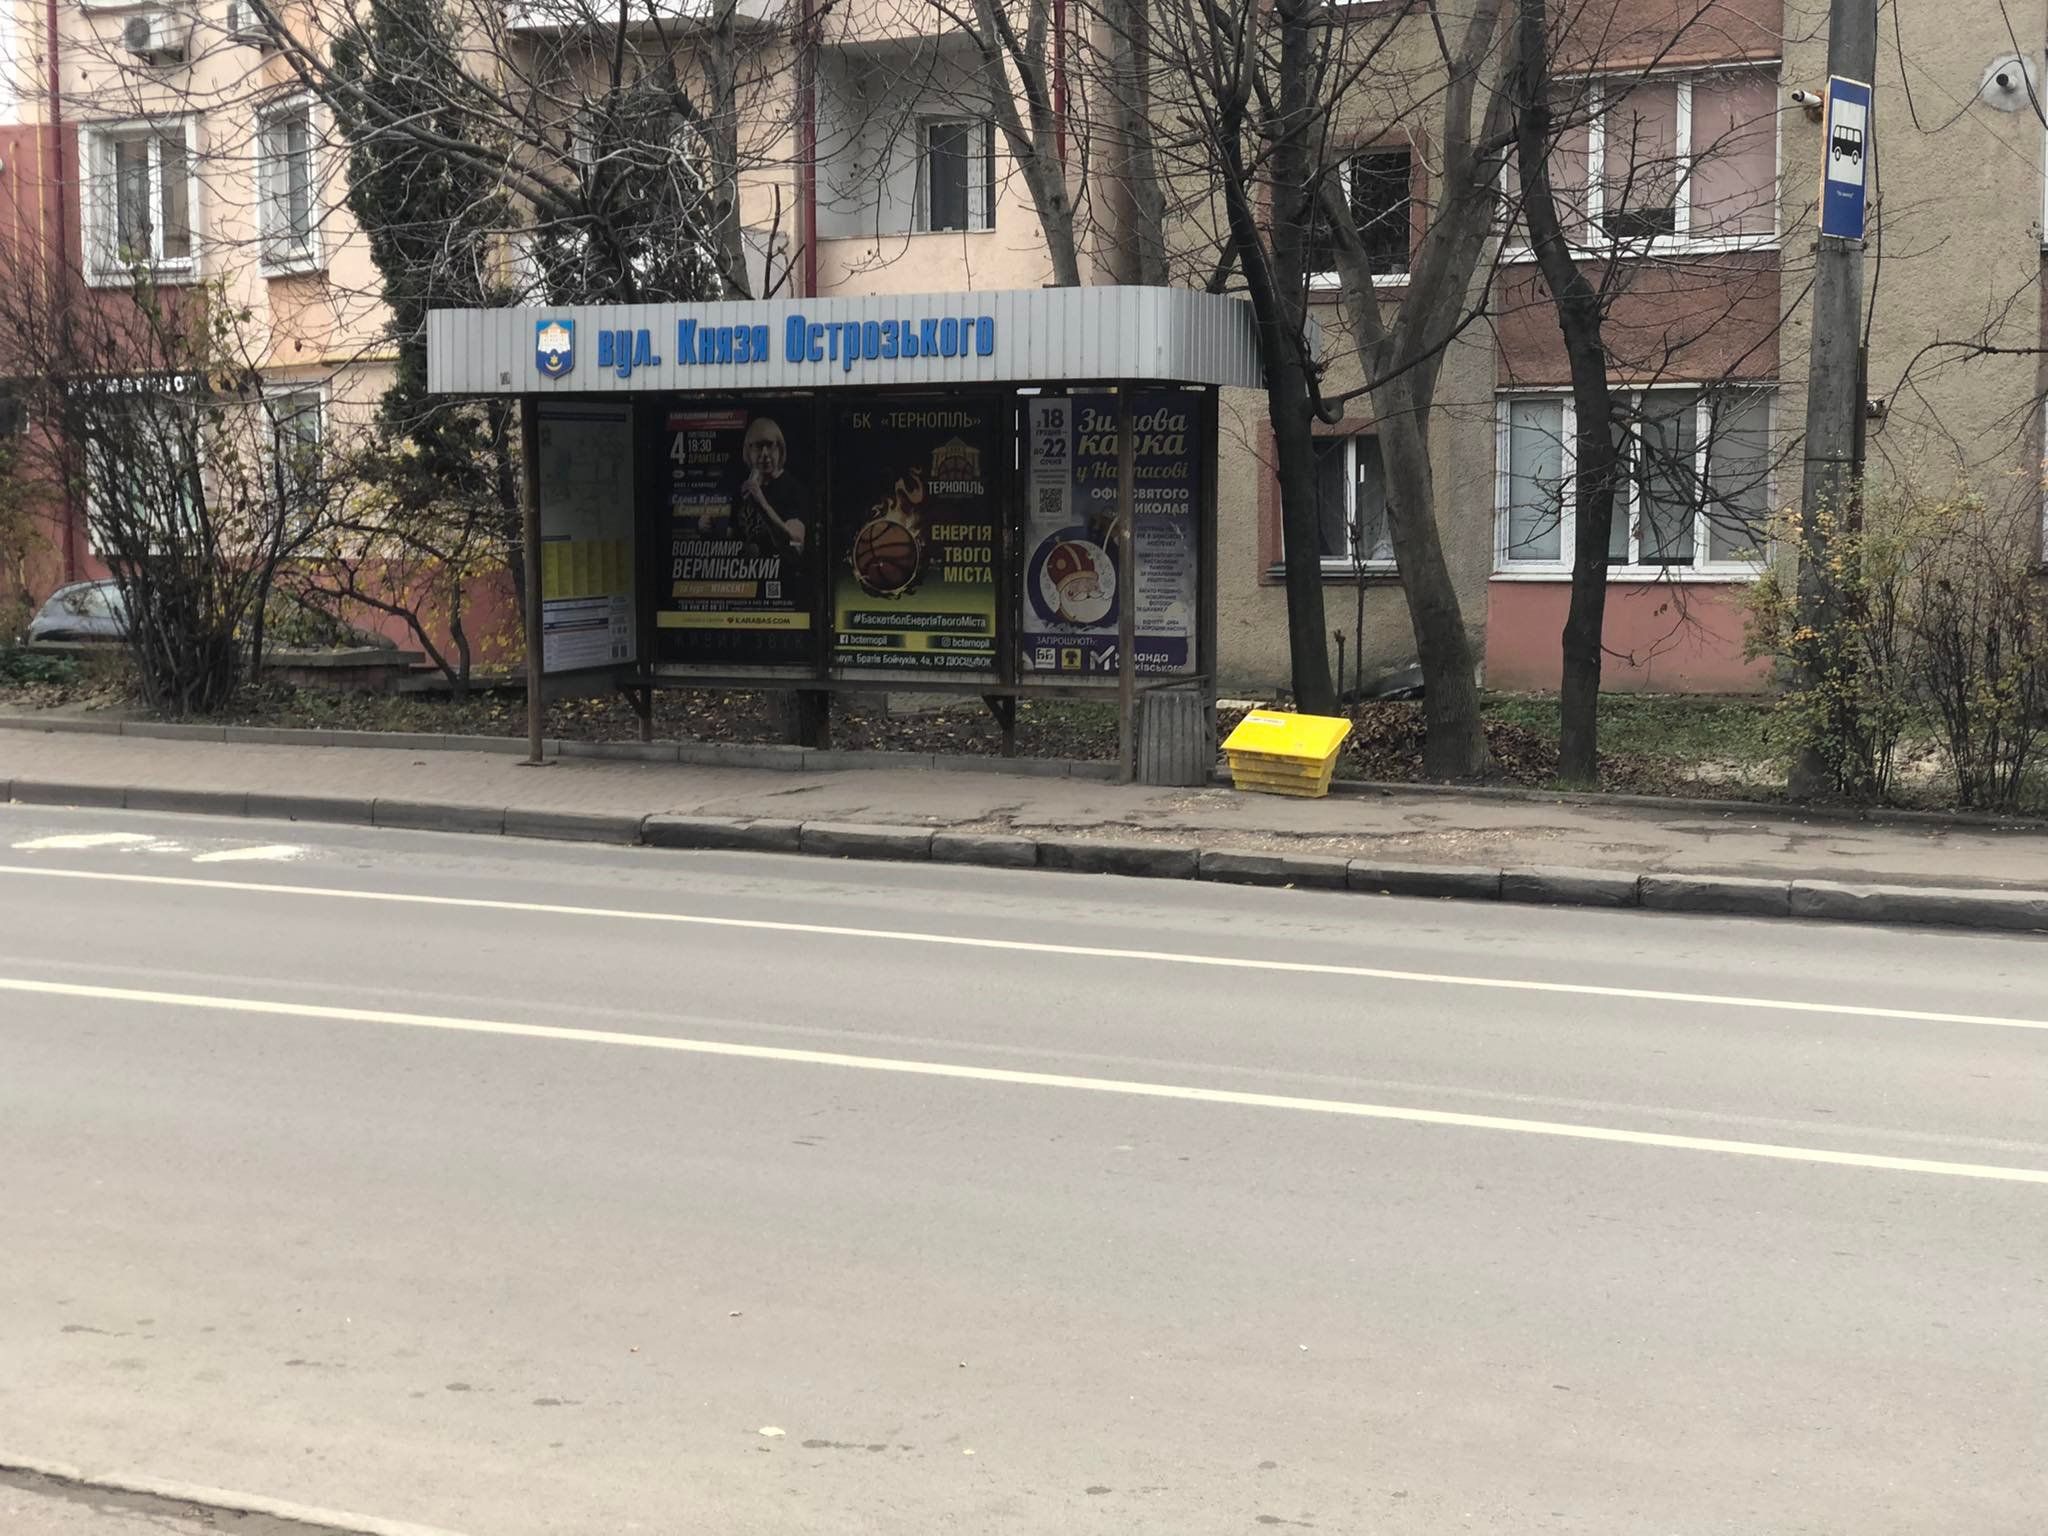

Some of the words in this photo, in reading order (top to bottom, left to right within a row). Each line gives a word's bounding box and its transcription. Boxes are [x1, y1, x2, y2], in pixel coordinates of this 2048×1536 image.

[597, 329, 661, 378] вул.
[677, 318, 769, 365] Князя
[784, 314, 995, 372] Острозького
[852, 412, 872, 429] БК
[880, 411, 983, 429] «ТЕРНОПІЛЬ»
[1041, 408, 1064, 428] 18
[670, 431, 686, 465] 4
[687, 438, 712, 453] 18:30
[1042, 438, 1066, 458] 22
[927, 480, 985, 496] ТЕРНОПІЛЬ
[1091, 487, 1120, 500] ОФІ
[1135, 502, 1190, 515] ИКОЛАЯ
[930, 524, 993, 541] ЕНЕРГІЯ
[672, 540, 743, 557] ВОЛОДИМИР
[943, 546, 992, 563] ТВОГО
[672, 554, 781, 580] ВЕРМІНСЬКИЙ
[943, 566, 993, 583] МІСТА
[853, 614, 986, 629] #БаскетболЕнергіяТвогоМіста
